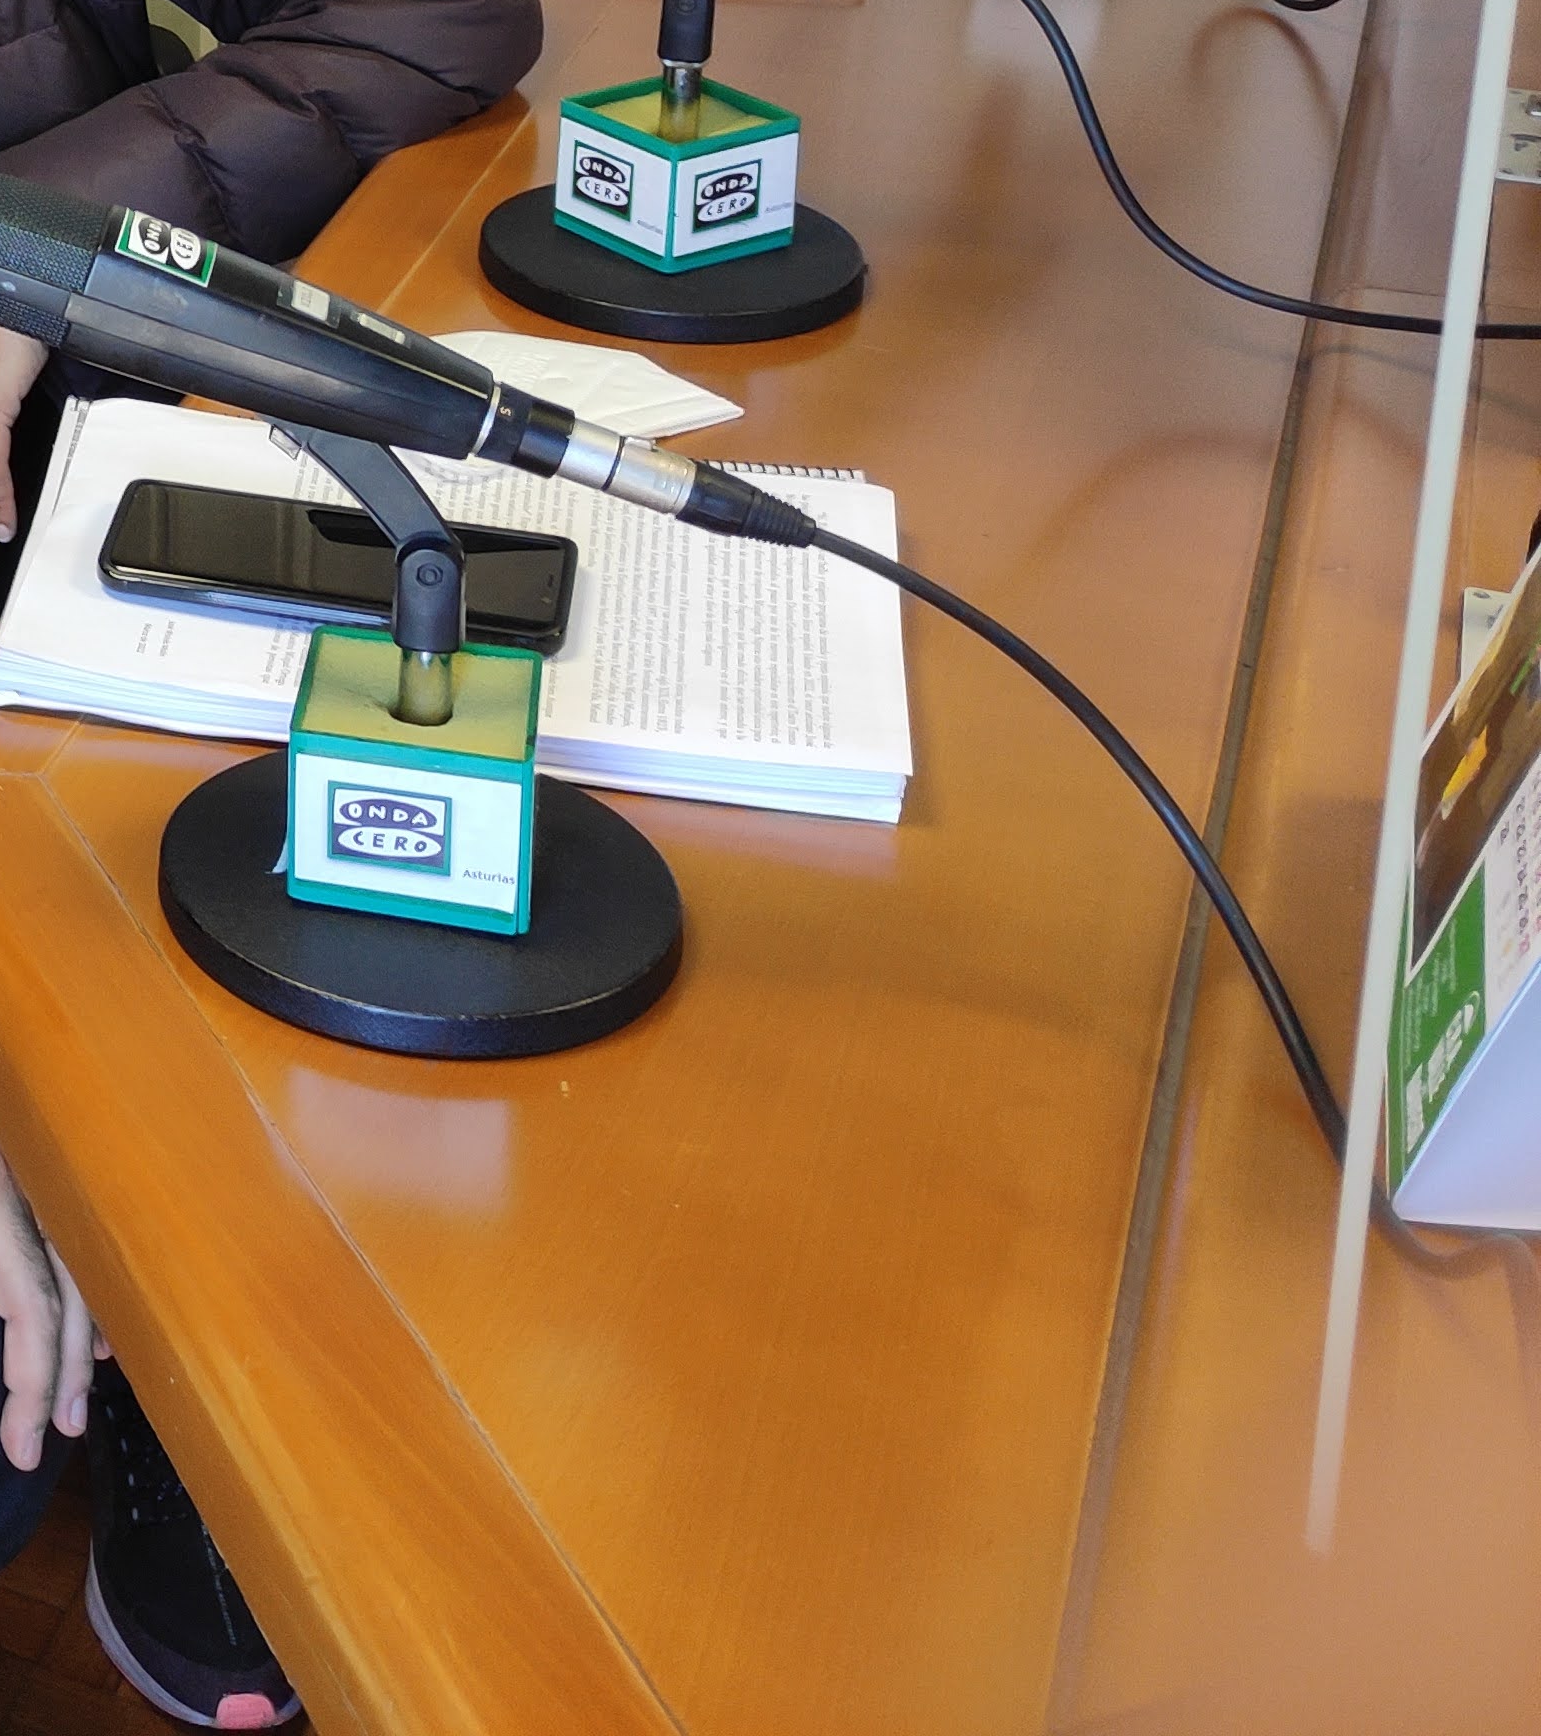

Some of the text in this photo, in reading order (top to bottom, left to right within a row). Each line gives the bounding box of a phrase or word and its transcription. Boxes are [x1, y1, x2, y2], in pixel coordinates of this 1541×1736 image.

[581, 158, 624, 182] ONDA
[584, 178, 621, 202] CERO
[704, 175, 750, 196] ONDA
[706, 196, 748, 216] CERO
[347, 802, 429, 826] ONDA
[352, 830, 428, 853] CERO
[461, 868, 516, 886] Asturias
